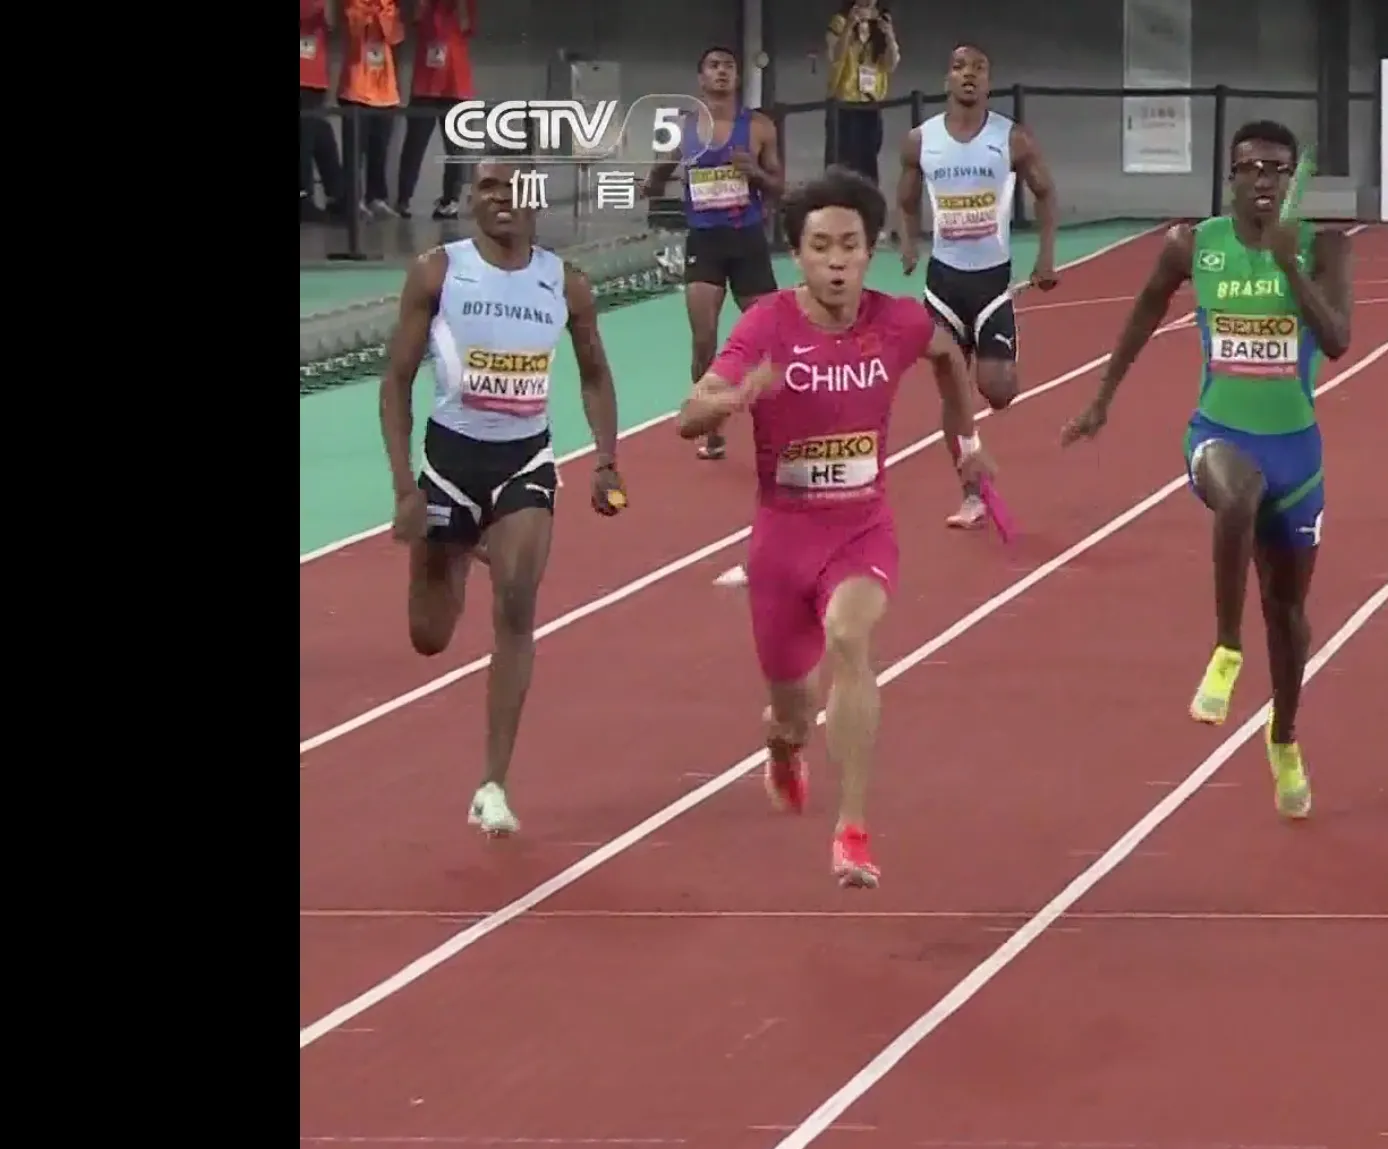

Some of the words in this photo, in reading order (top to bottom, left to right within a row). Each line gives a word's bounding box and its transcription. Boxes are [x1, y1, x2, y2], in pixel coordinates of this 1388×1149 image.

[932, 165, 996, 180] BOTSWANA
[938, 191, 996, 210] SEIKO
[1216, 277, 1285, 299] BRASIL
[462, 301, 554, 324] BOTSWANA
[1214, 315, 1295, 336] SEIKO
[1220, 340, 1289, 359] BARDI
[468, 350, 549, 372] SEIKO
[469, 374, 508, 394] VAN
[513, 378, 546, 396] WYK
[785, 358, 890, 392] CHINA
[782, 434, 874, 462] SEIKO
[811, 463, 846, 484] HE
